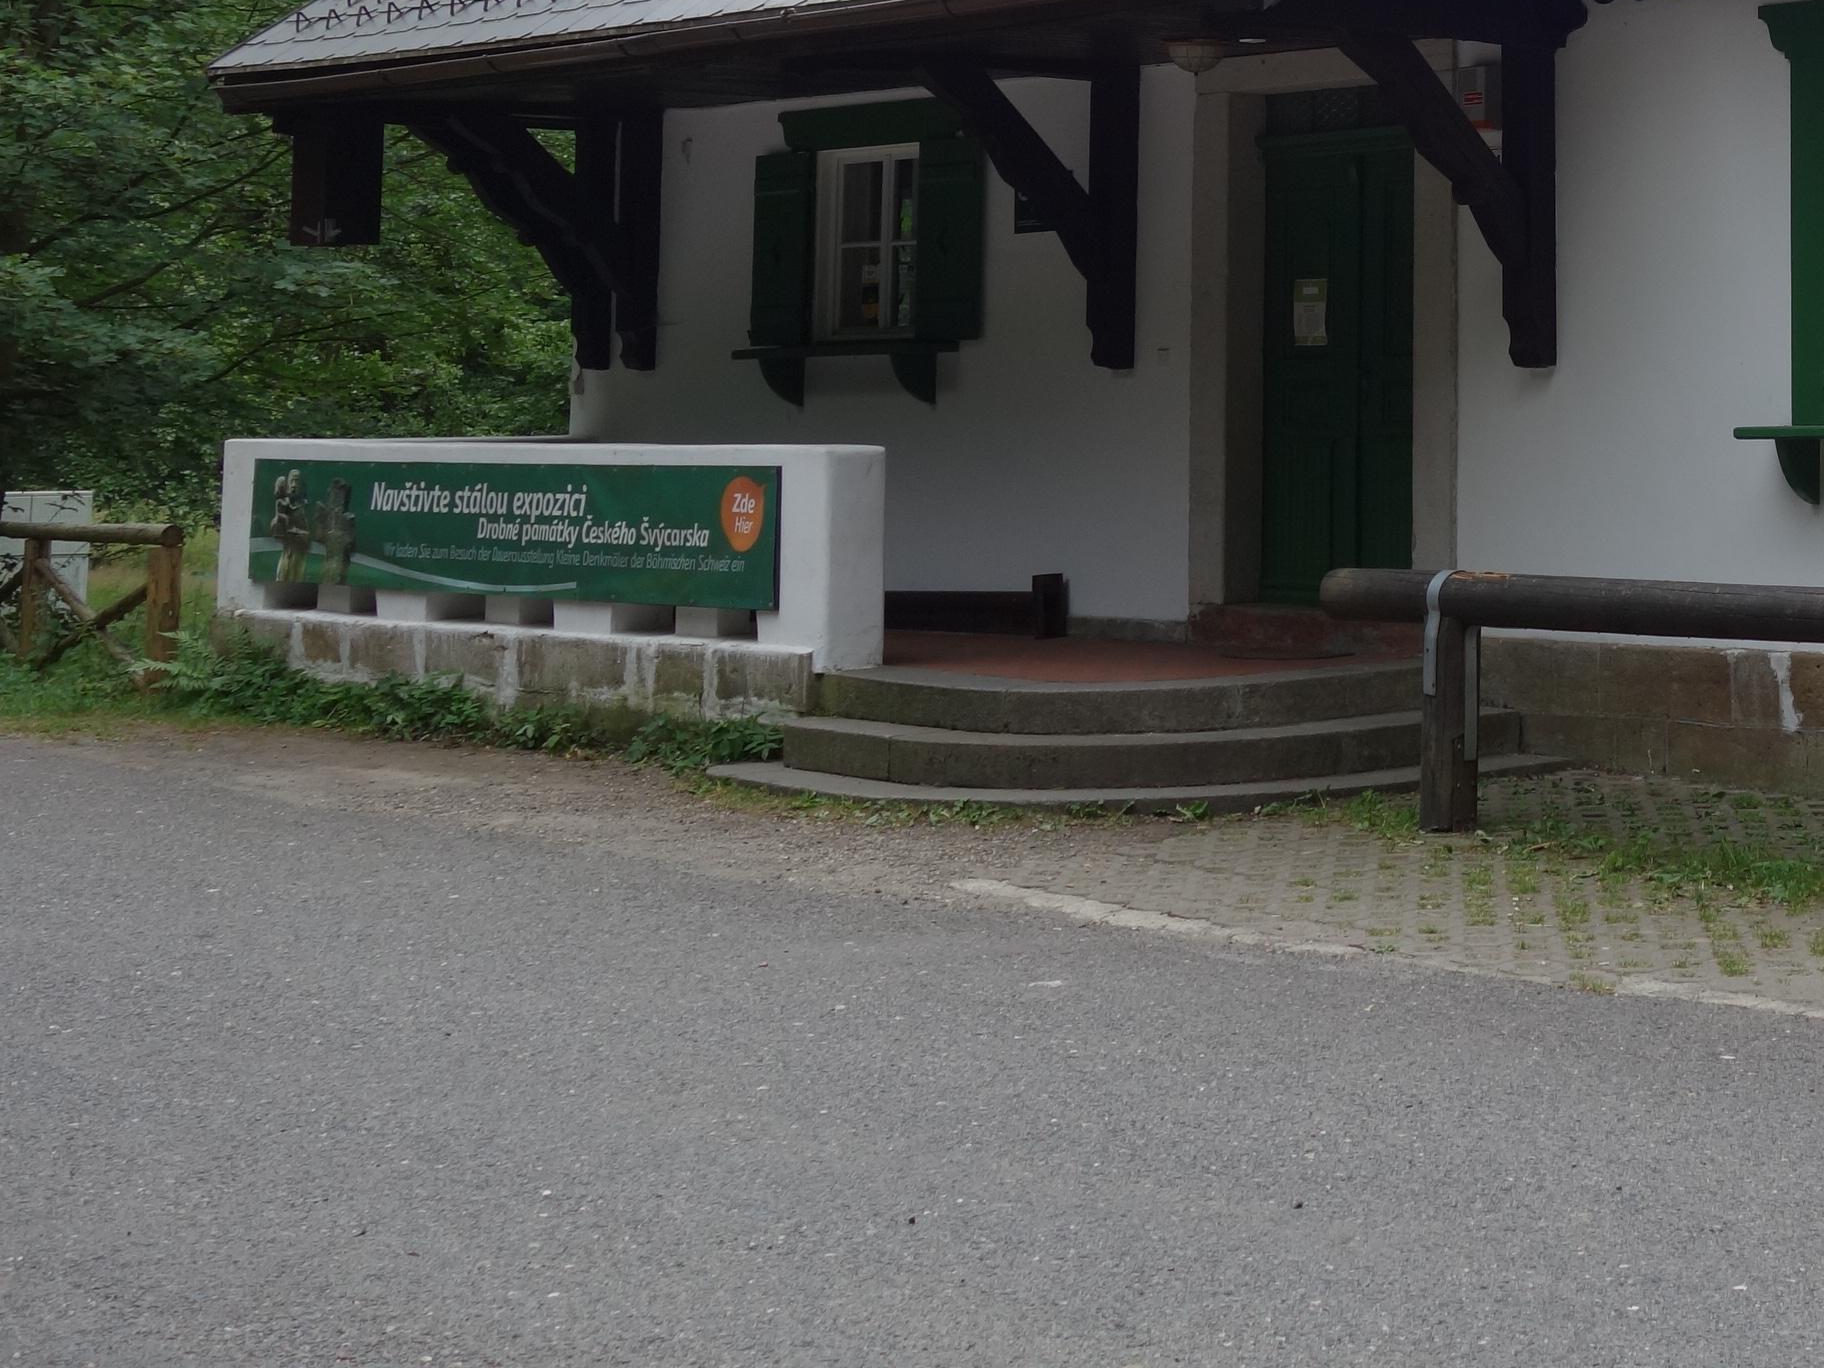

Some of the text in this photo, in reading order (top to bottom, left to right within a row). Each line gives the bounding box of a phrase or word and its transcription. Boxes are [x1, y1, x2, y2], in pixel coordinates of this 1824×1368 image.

[370, 482, 588, 523] Navštivte stálou expozici
[732, 493, 756, 514] Zde
[477, 515, 710, 551] Drobné památky Českého Švýcarska
[734, 516, 754, 534] Hier
[395, 543, 417, 557] laden
[418, 544, 431, 559] Sie
[431, 547, 449, 560] zum
[449, 545, 478, 561] Besuch
[478, 546, 492, 561] der
[492, 546, 554, 568] Dauerausstellung
[556, 550, 580, 566] Kleine
[582, 550, 629, 568] Denkmäler
[630, 552, 645, 569] der
[646, 552, 696, 571] Böhmischen
[697, 554, 729, 572] Schweiz
[730, 558, 745, 572] ein
